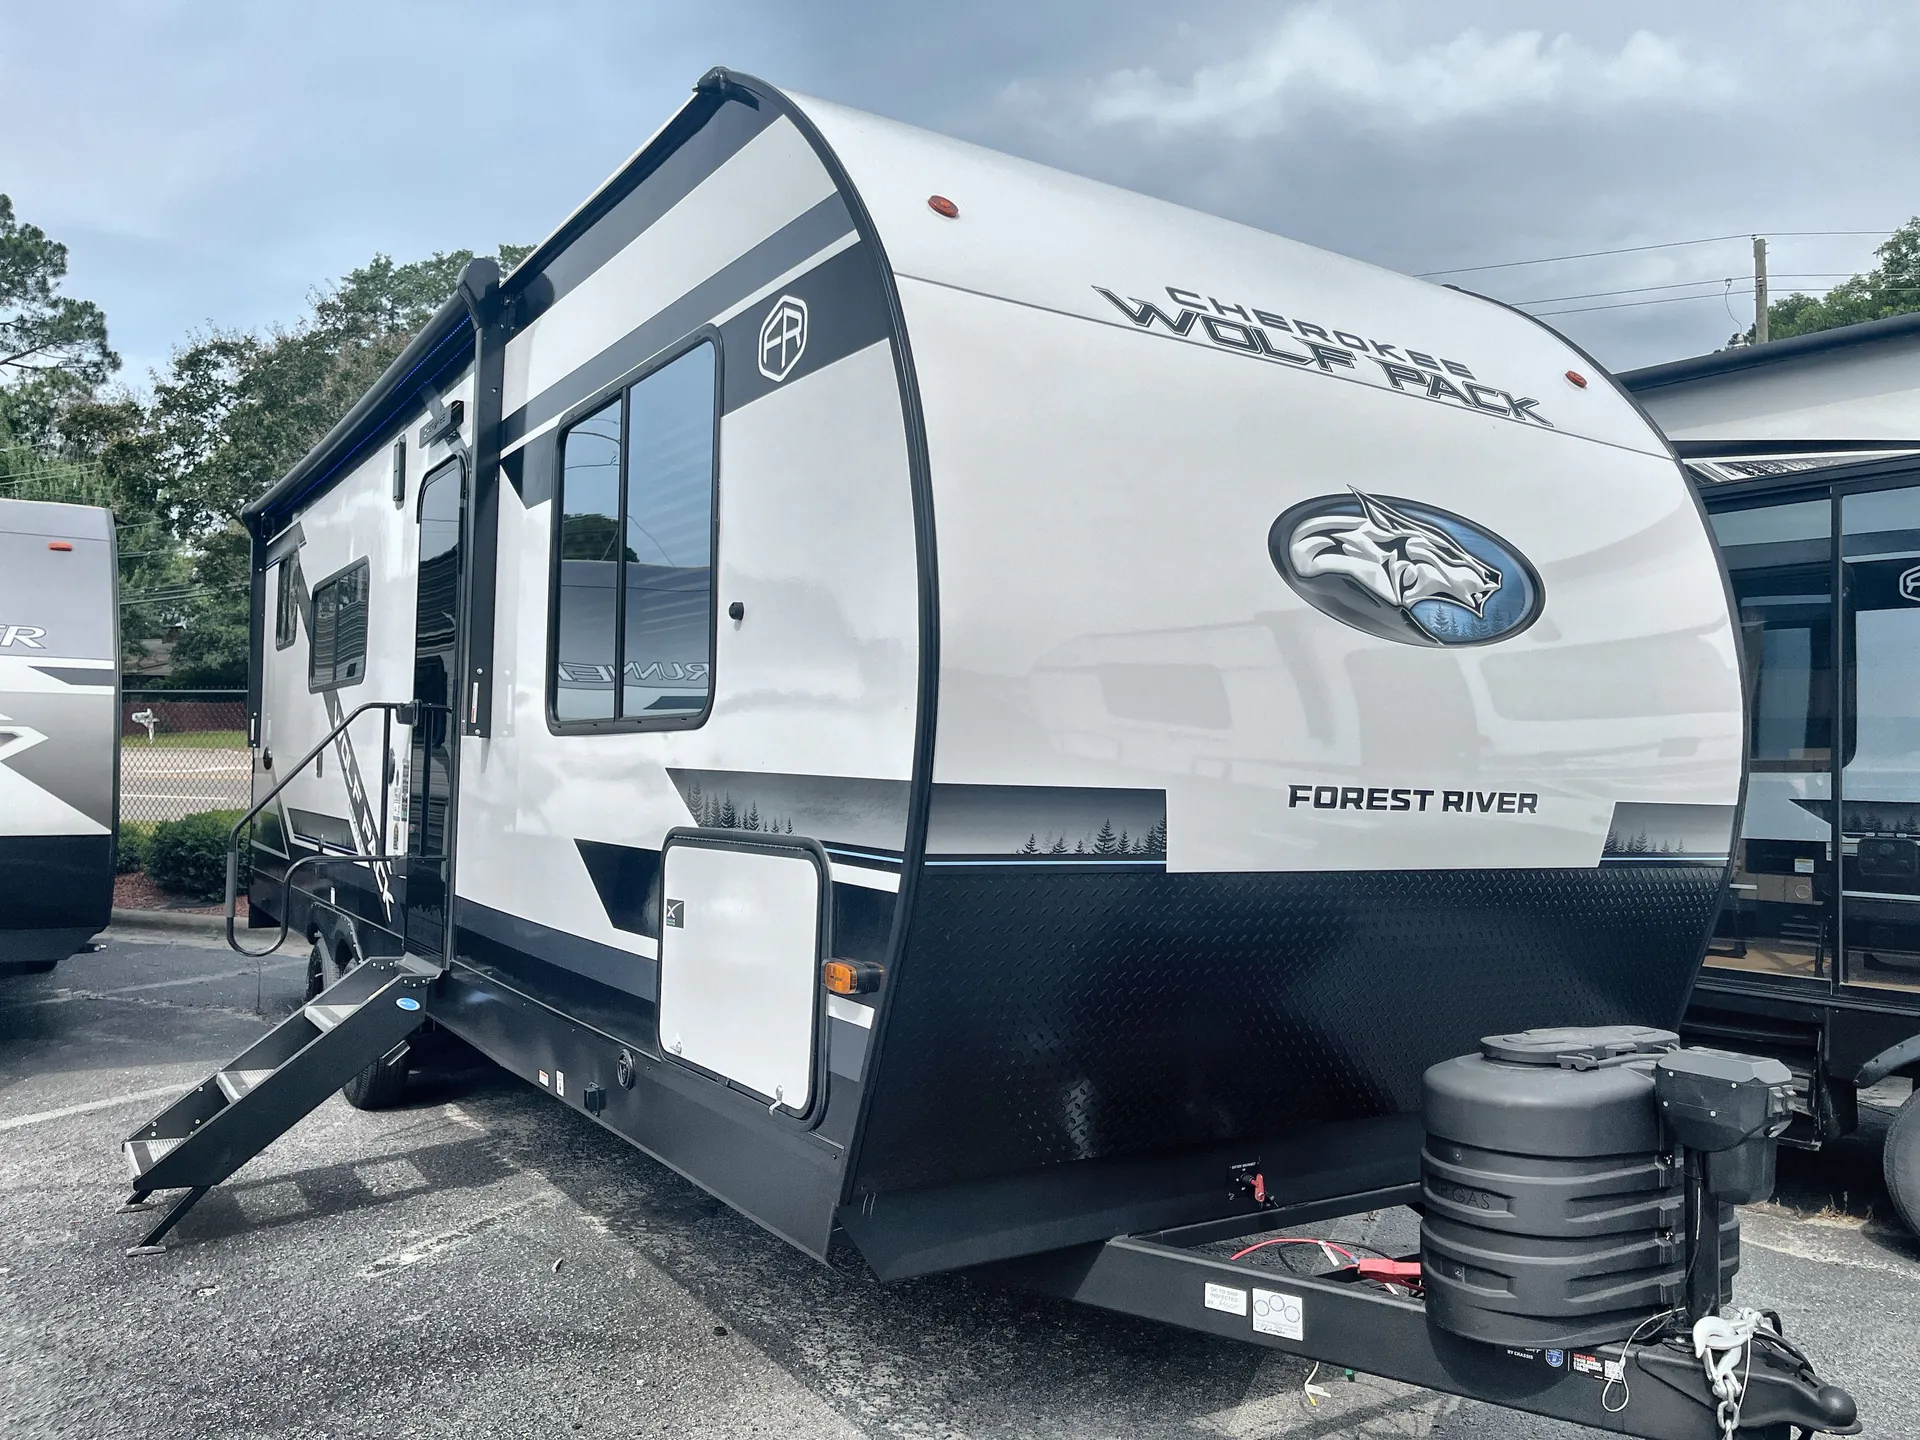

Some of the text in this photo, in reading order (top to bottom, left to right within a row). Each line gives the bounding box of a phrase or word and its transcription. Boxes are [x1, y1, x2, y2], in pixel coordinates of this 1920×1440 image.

[1165, 286, 1477, 381] CHEROKEE
[1090, 285, 1555, 428] WOLF PACK
[0, 624, 47, 649] R
[334, 699, 363, 805] WOLF
[361, 805, 395, 924] PACK
[1288, 785, 1538, 814] FOREST RIVER
[1453, 1186, 1491, 1209] GAS
[1210, 1292, 1239, 1303] INSPECTED
[1514, 1350, 1534, 1360] CHASSIS
